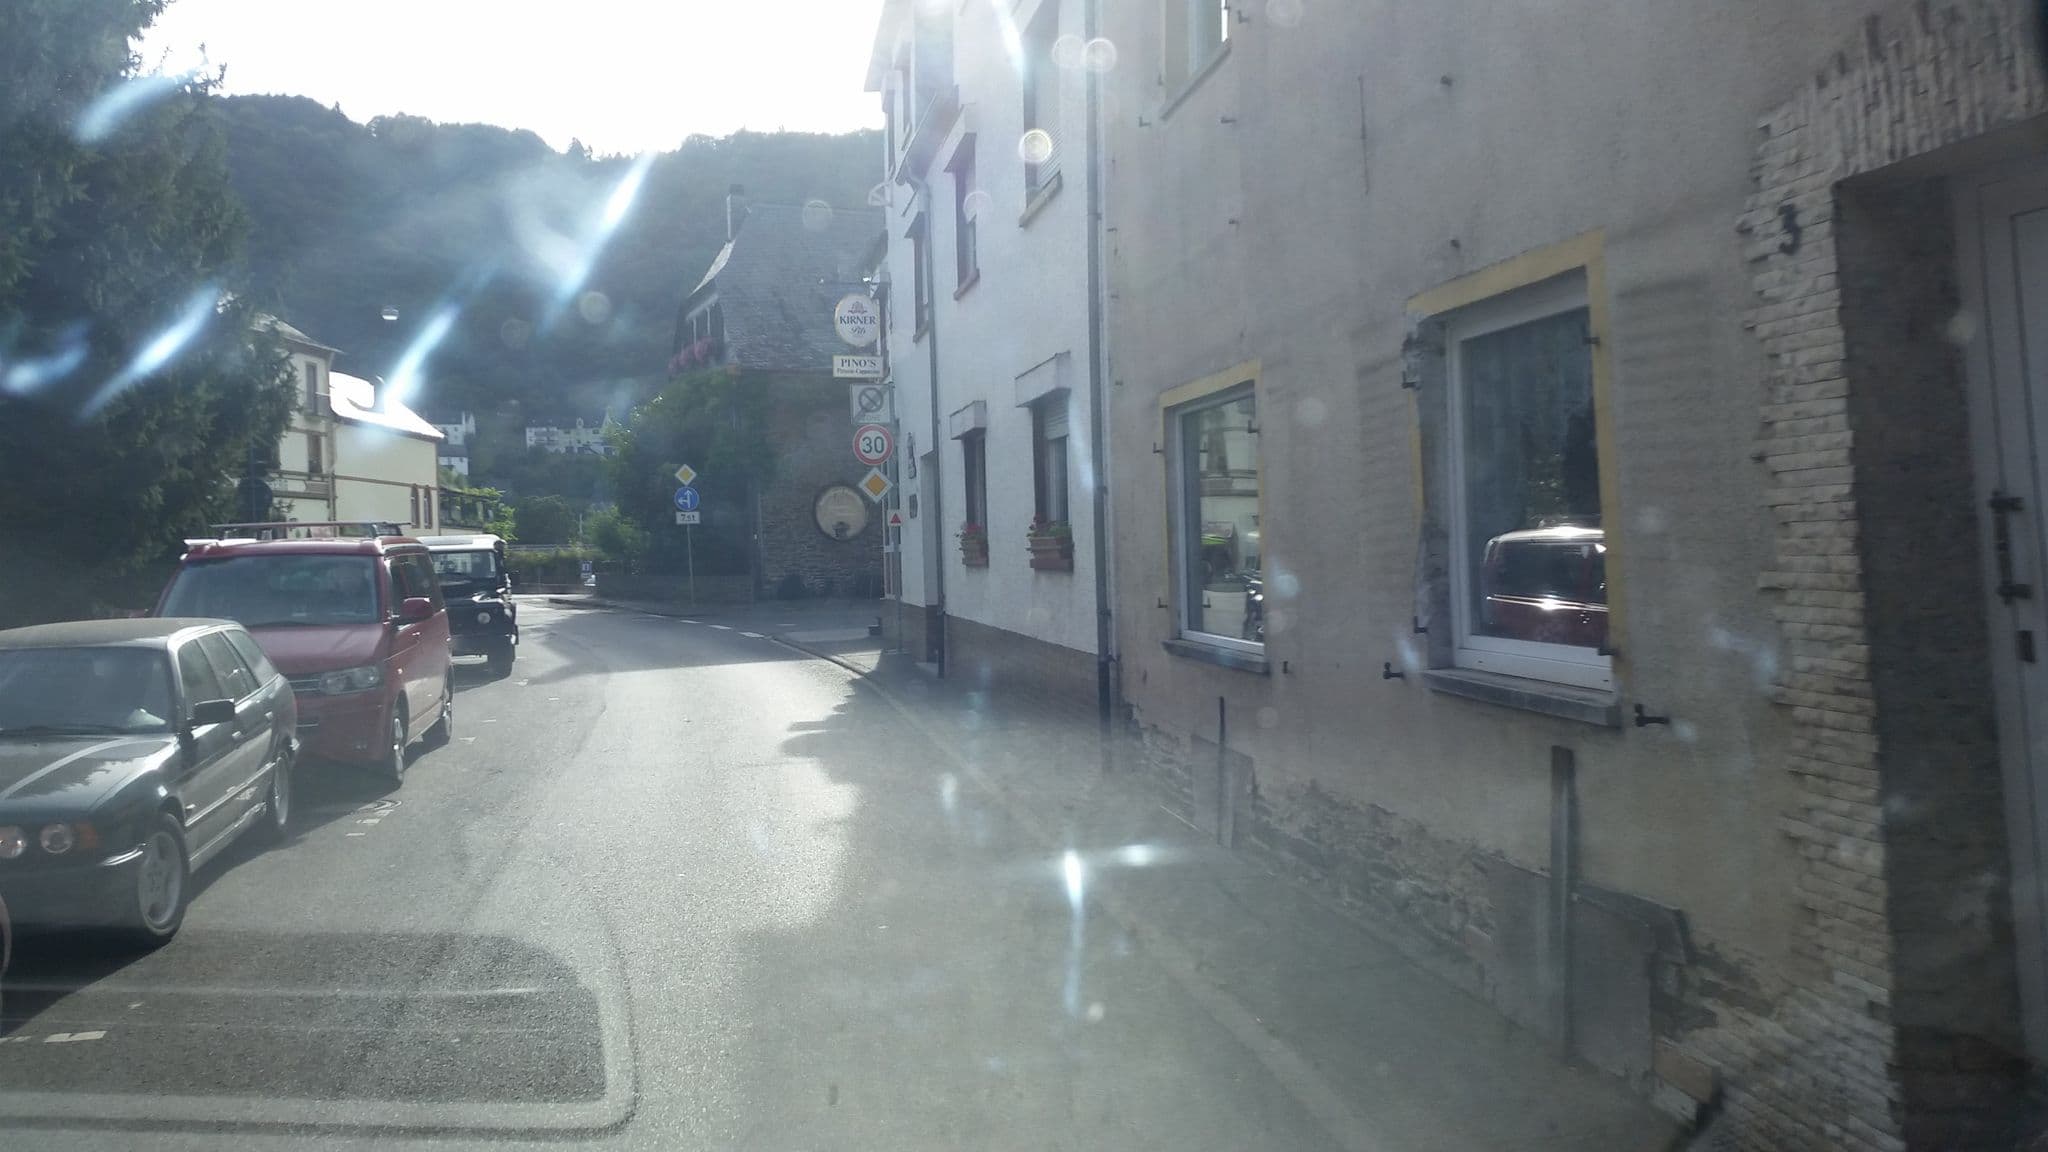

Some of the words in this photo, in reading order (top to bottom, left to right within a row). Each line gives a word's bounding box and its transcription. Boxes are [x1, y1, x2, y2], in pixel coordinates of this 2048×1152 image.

[1776, 204, 1801, 254] 3
[839, 315, 876, 325] KIRNER
[840, 358, 877, 368] PINO'S
[862, 436, 884, 454] 30
